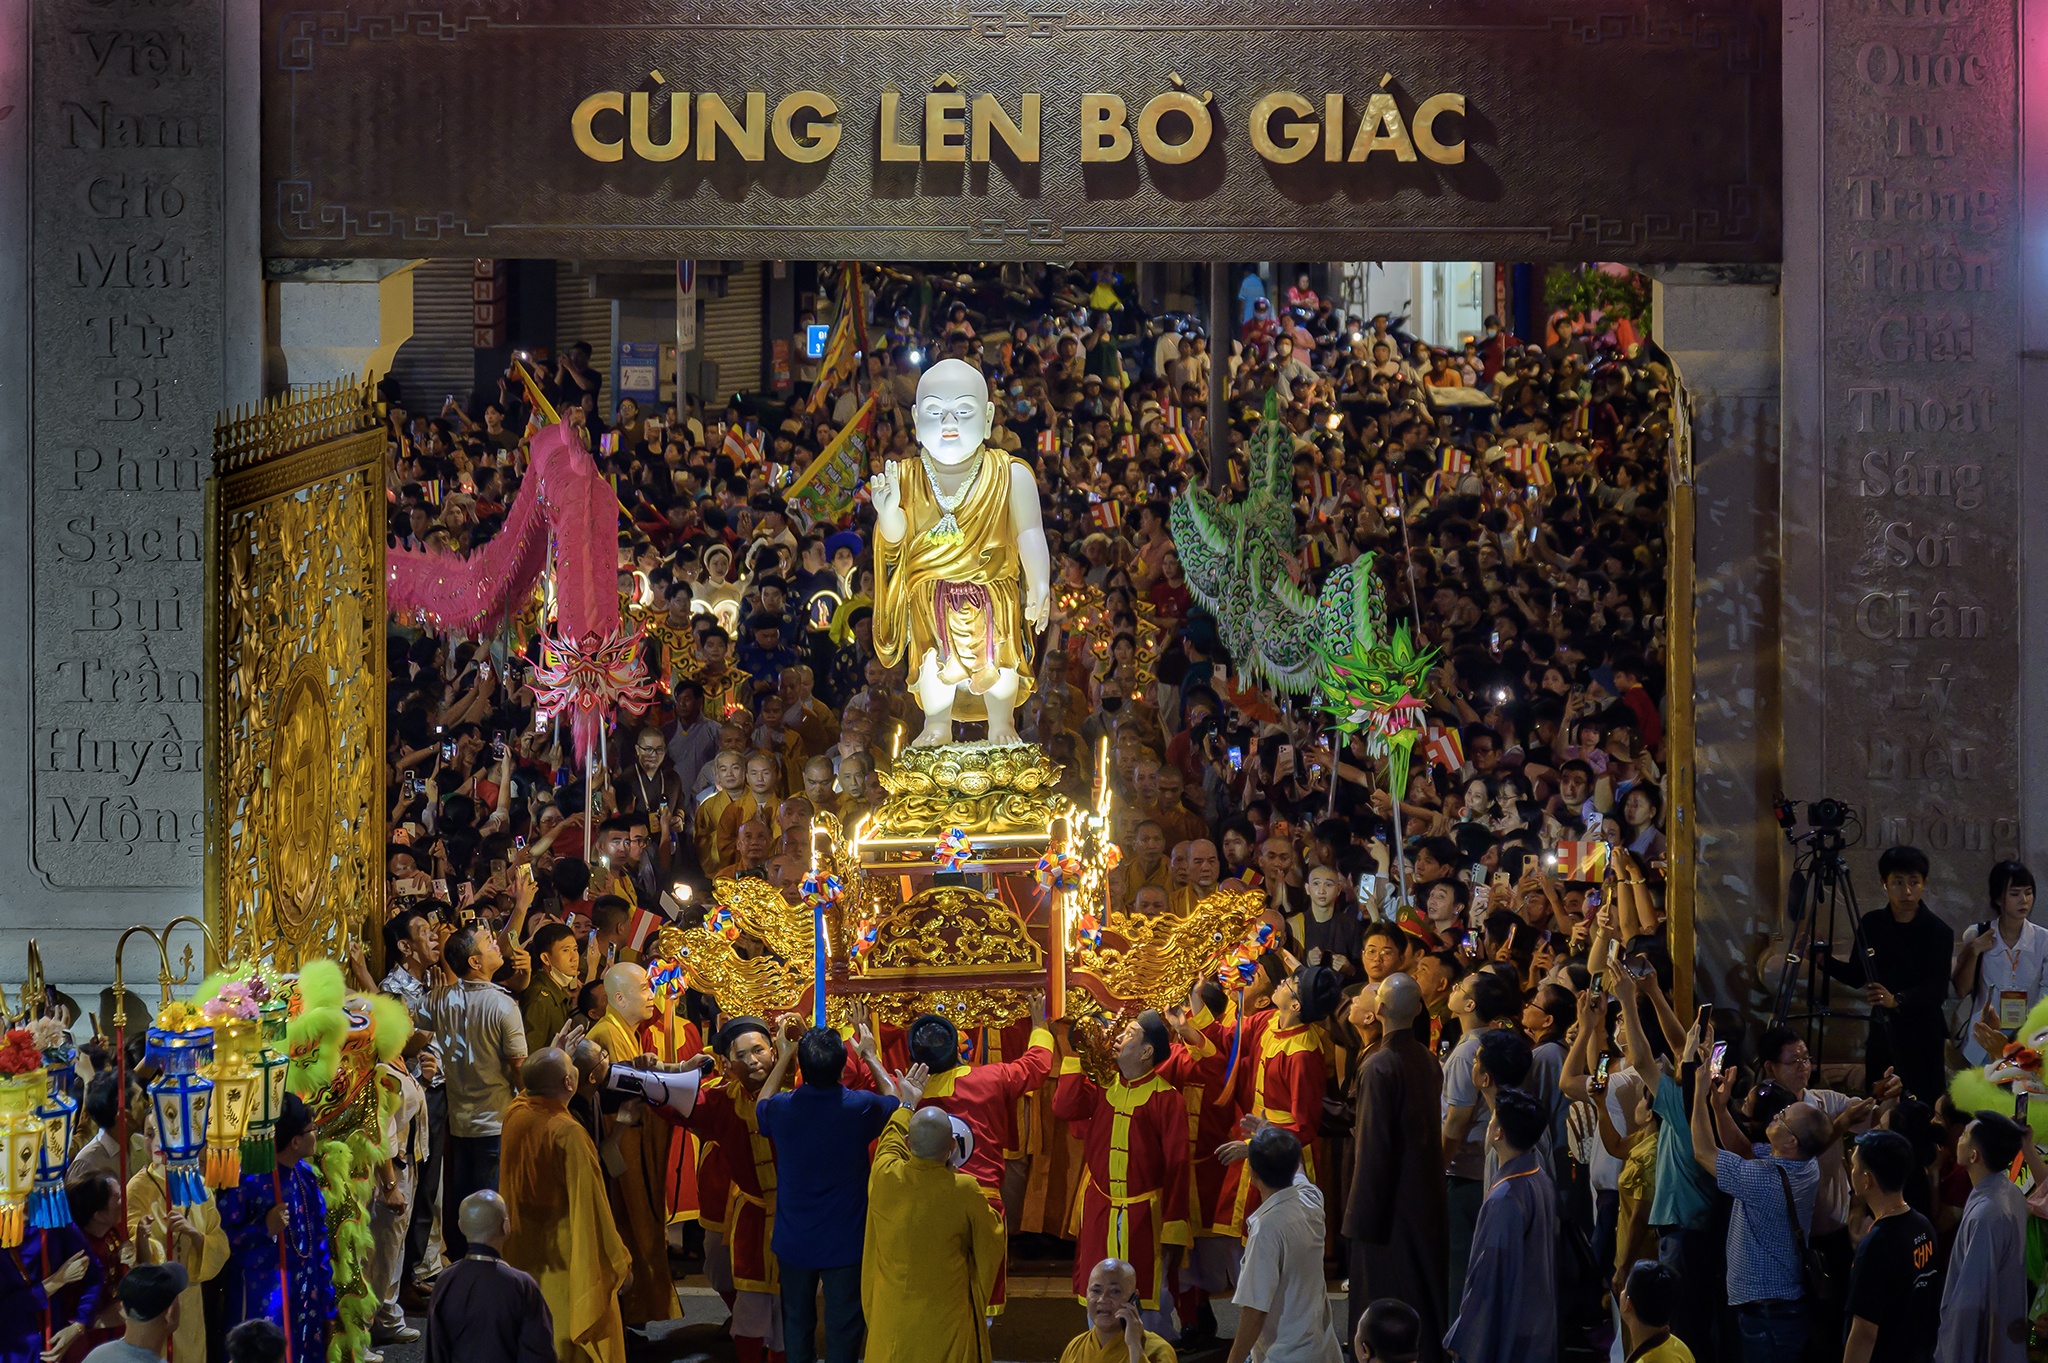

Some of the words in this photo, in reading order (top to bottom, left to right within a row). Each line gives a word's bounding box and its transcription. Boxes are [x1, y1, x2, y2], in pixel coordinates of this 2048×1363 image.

[68, 27, 193, 90] Việt
[1857, 28, 1987, 97] Quốc
[60, 101, 203, 149] Nam
[571, 69, 842, 163] CÙNG
[880, 72, 1041, 163] LÊN
[1081, 71, 1213, 164] BỜ
[1249, 71, 1466, 164] GIÁC
[1885, 112, 1959, 170] Tự
[80, 172, 185, 220] Gió
[1850, 232, 1995, 292] Thiền
[477, 260, 490, 345] CHUK
[84, 310, 175, 360] Từ
[98, 375, 163, 423] Bi
[1848, 384, 1998, 433] Thoát
[52, 445, 201, 492] Phủi
[1860, 451, 1983, 510] Sáng
[55, 515, 202, 574] Sạch
[1884, 521, 1962, 568] Soi
[1856, 589, 1988, 640] Chân
[53, 644, 202, 704] Trần
[1890, 663, 1957, 720] Lý
[1867, 732, 1980, 793] Diệu
